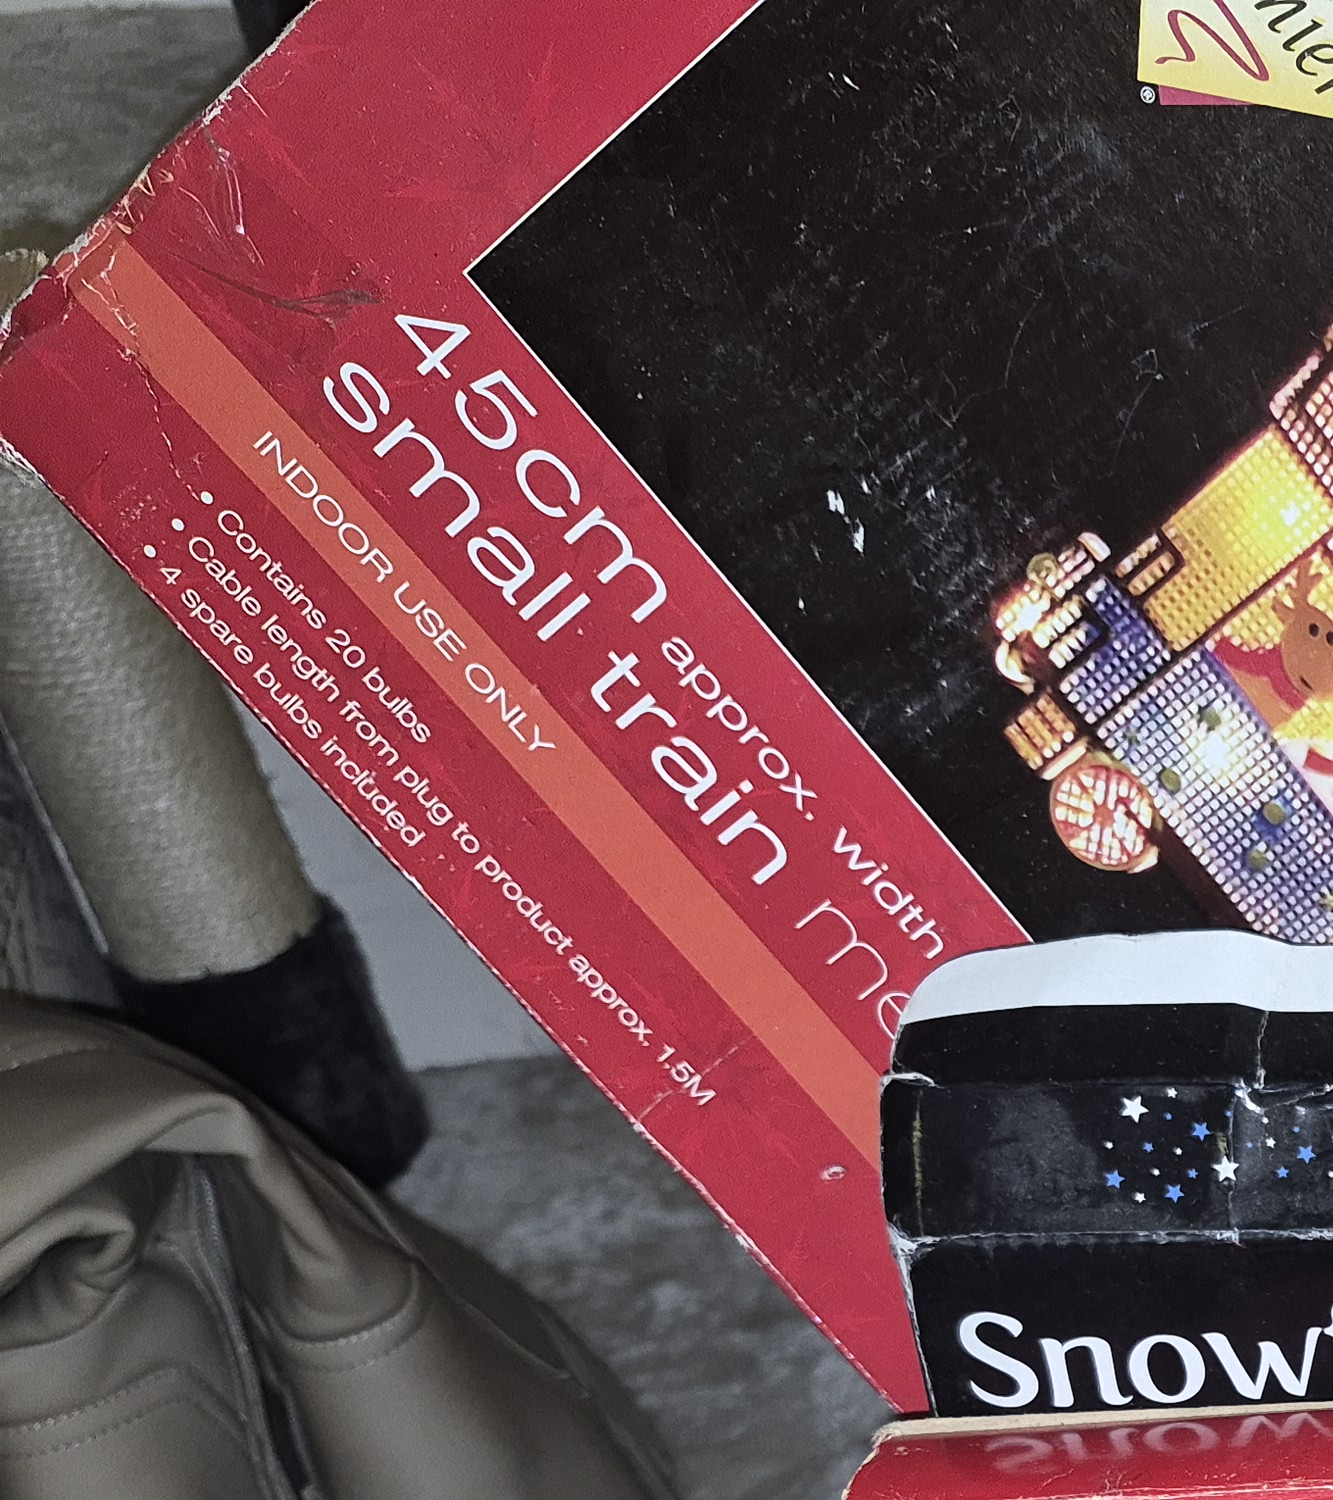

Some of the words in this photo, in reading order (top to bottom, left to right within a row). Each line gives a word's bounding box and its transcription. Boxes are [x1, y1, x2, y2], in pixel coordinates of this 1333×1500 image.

[159, 566, 180, 586] 4
[180, 588, 256, 666] spare
[252, 662, 322, 740] bulbs
[320, 738, 426, 848] included
[188, 536, 262, 619] Cable
[258, 617, 336, 706] length
[338, 702, 400, 769] from
[391, 764, 453, 831] plug
[452, 818, 481, 855] to
[474, 853, 574, 955] product
[217, 509, 327, 628] Contains
[327, 628, 366, 669] 20
[364, 670, 431, 744] bulbs
[253, 431, 393, 583] INDOOR
[393, 584, 467, 659] USE
[466, 662, 556, 753] ONLY
[323, 361, 591, 642] small
[588, 650, 789, 887] train
[396, 314, 670, 624] 45cm
[661, 636, 816, 822] approx.
[832, 826, 947, 960] width
